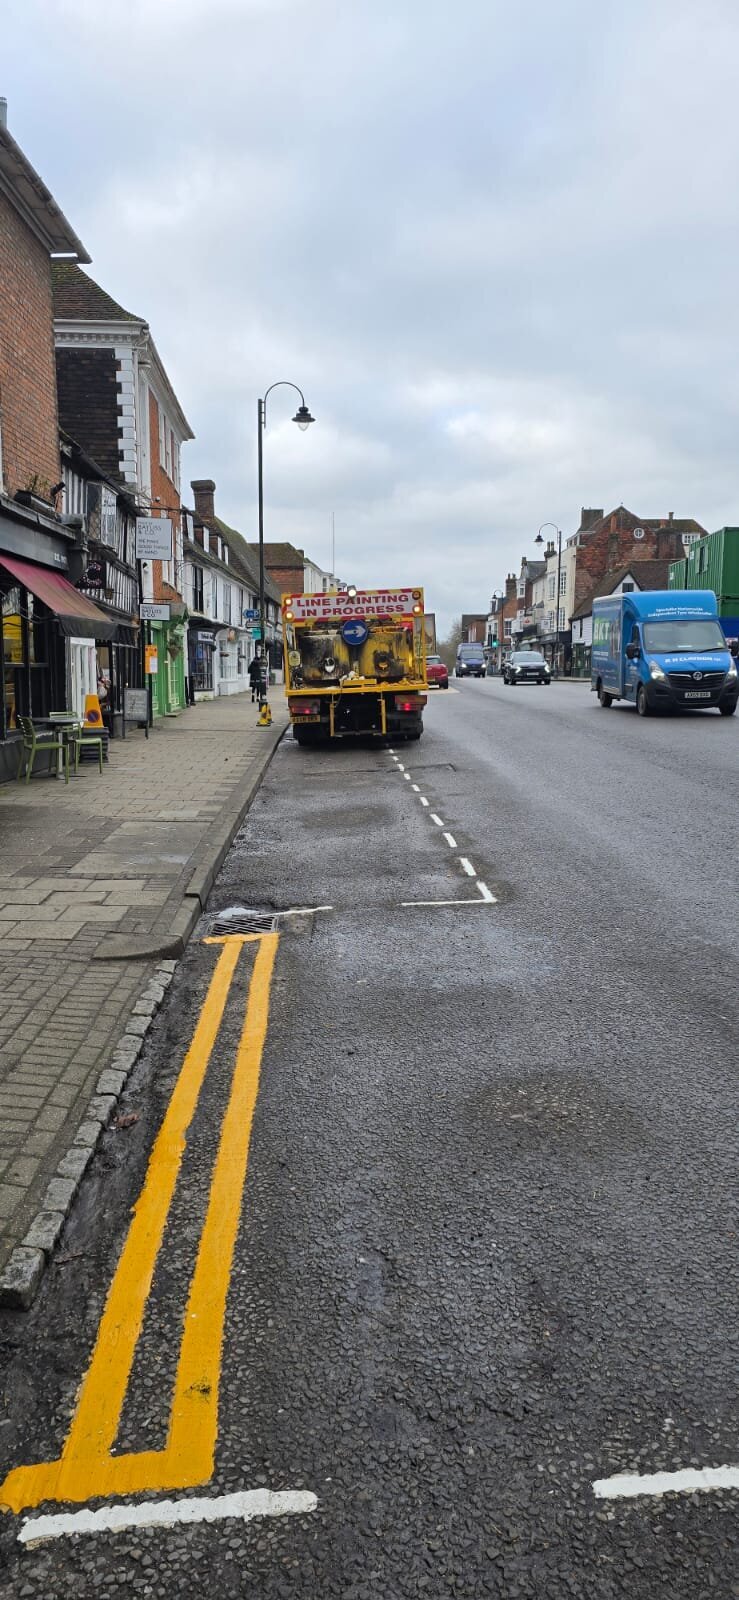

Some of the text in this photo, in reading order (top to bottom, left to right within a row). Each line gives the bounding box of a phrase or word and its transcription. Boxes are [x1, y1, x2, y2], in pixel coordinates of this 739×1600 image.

[296, 594, 409, 607] LINE PAINTING
[301, 605, 405, 617] IN PROGRESS
[593, 622, 609, 641] BKT
